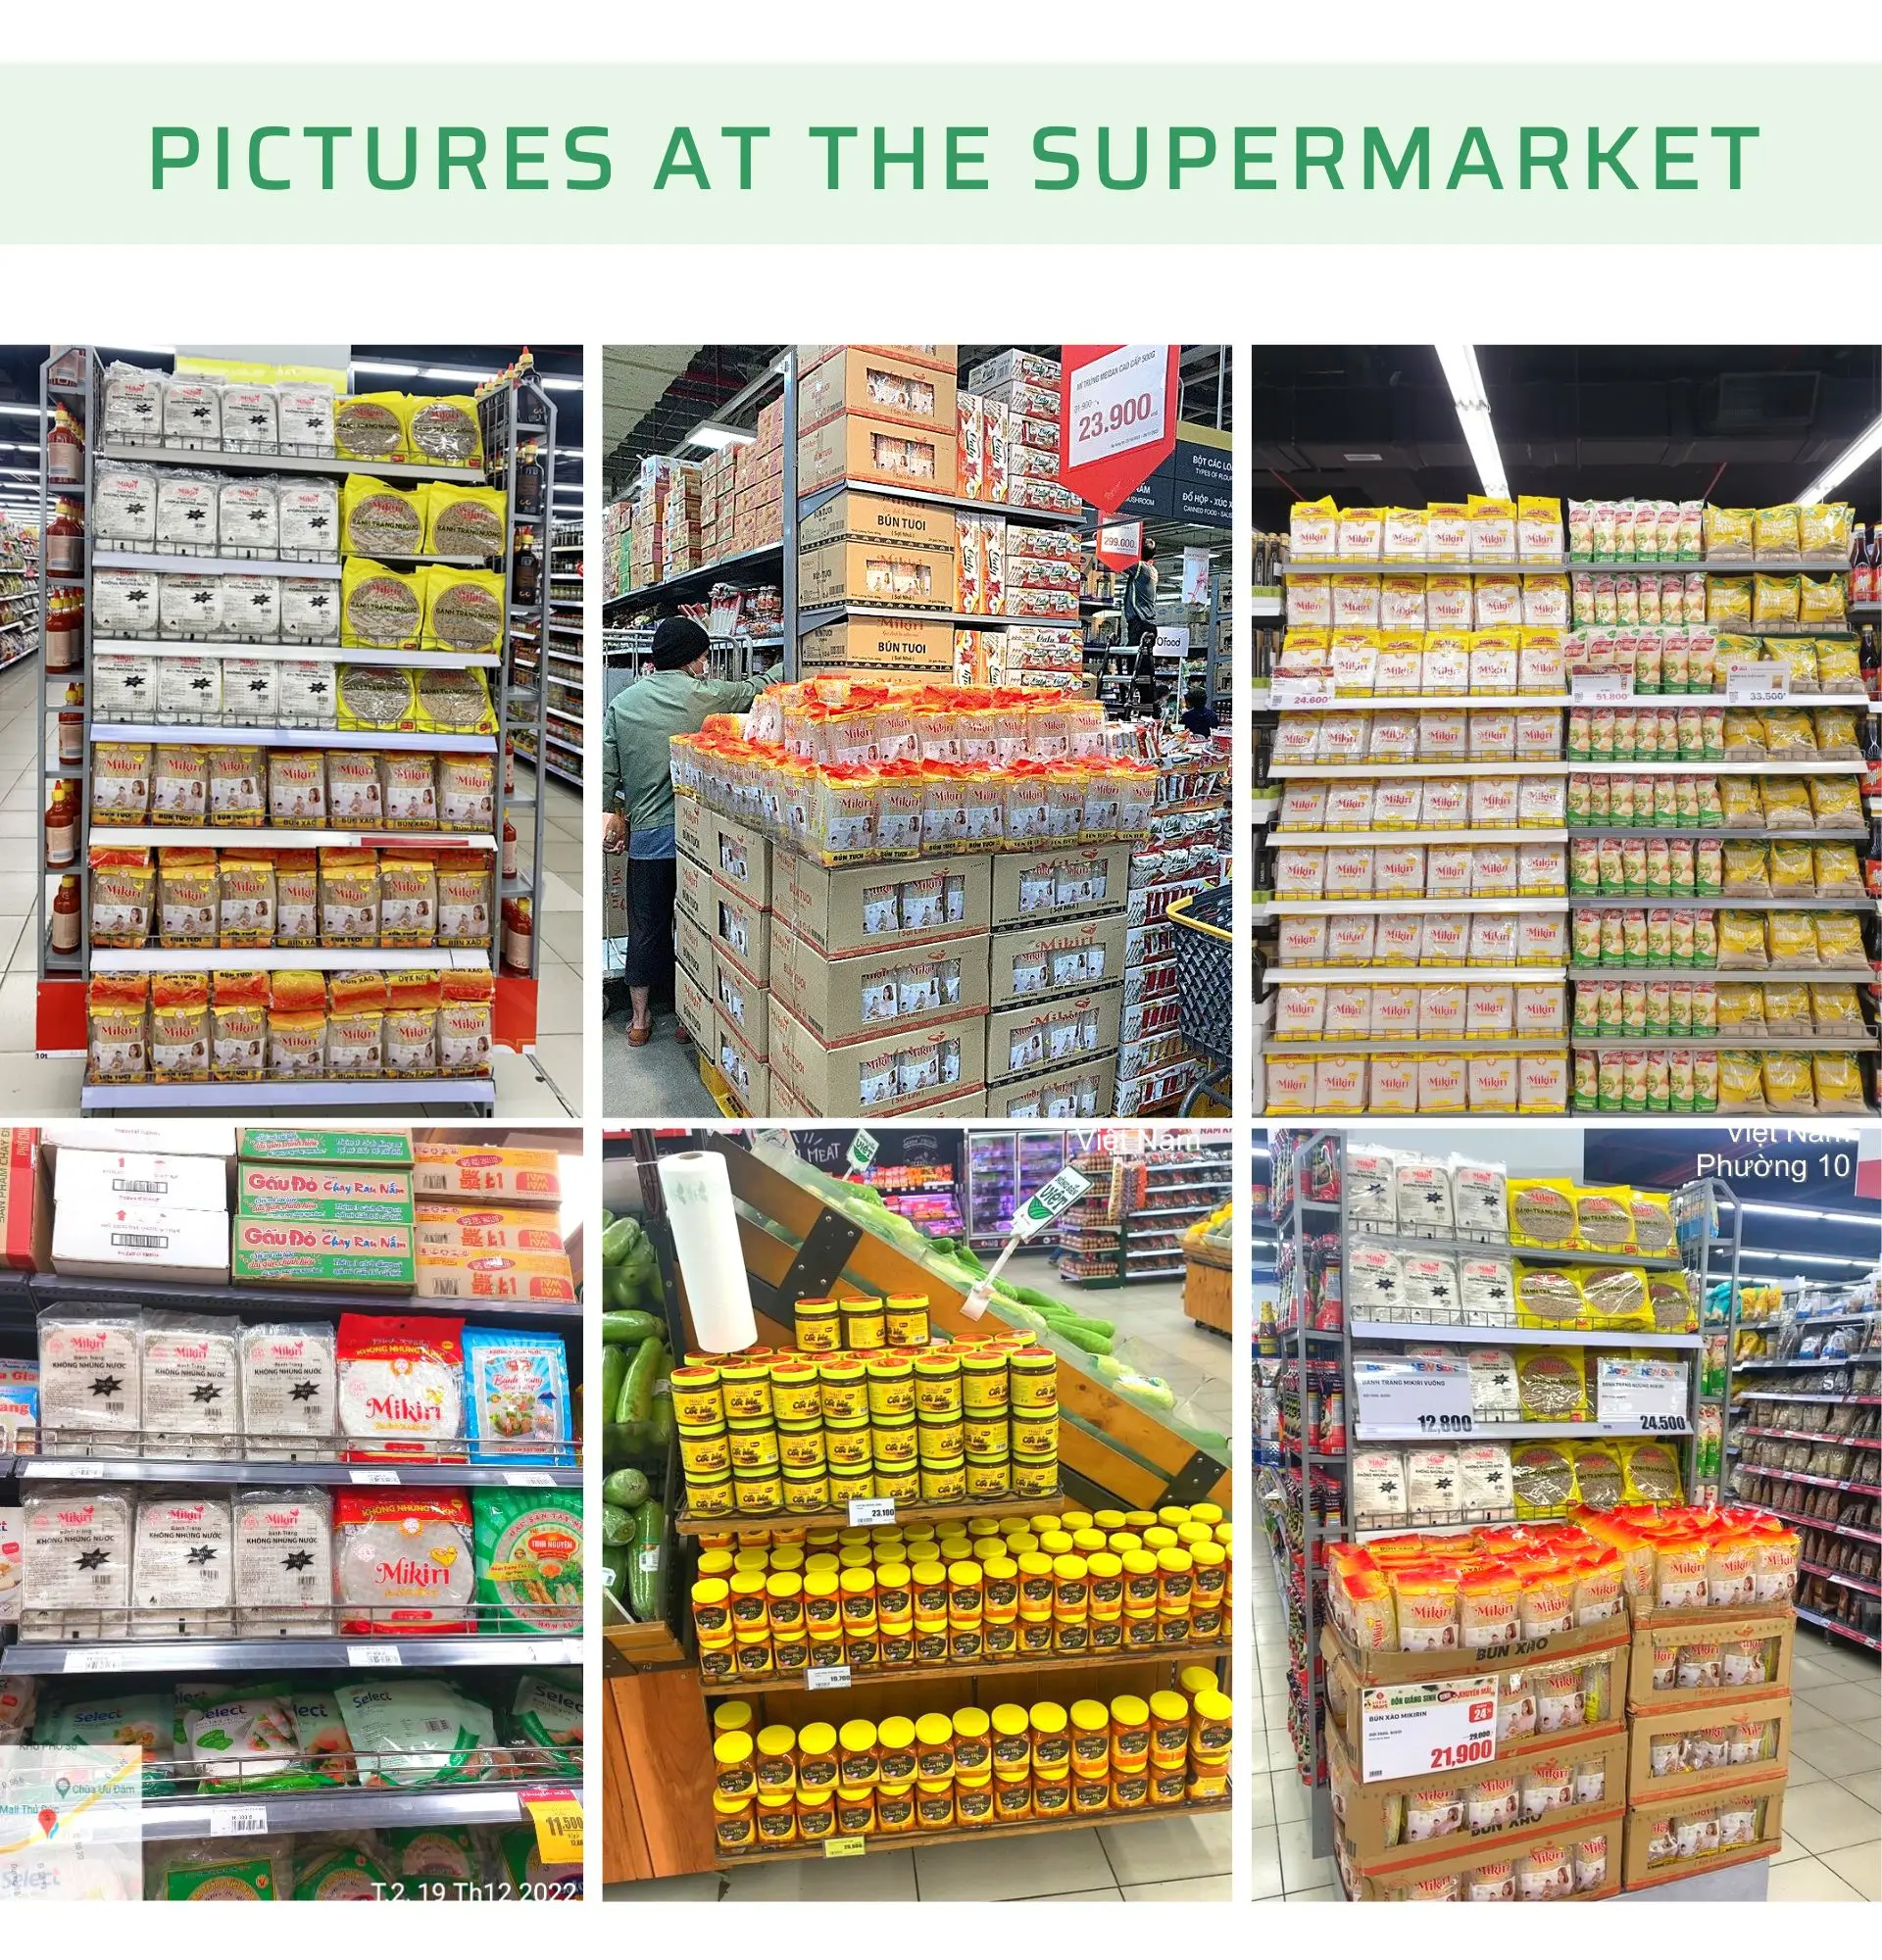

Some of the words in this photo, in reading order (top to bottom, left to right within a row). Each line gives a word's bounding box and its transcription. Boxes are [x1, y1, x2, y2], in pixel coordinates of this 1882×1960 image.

[1078, 392, 1152, 442] 23.900
[877, 514, 900, 528] BÚN
[878, 640, 900, 654] BÚN
[1294, 696, 1328, 705] 24.600
[1750, 692, 1784, 701] 33.500
[808, 1143, 841, 1163] MEAT
[354, 1182, 377, 1194] Rau
[245, 1227, 287, 1247] Gấu
[289, 1229, 317, 1248] Đỏ
[322, 1234, 351, 1249] Chay
[354, 1236, 377, 1249] Rau
[366, 1396, 442, 1422] Mikiri
[1417, 1414, 1473, 1434] 12,800
[375, 1556, 451, 1587] Mikiri
[353, 1690, 393, 1709] Select
[74, 1709, 123, 1723] Select
[1431, 1740, 1493, 1769] 21,900
